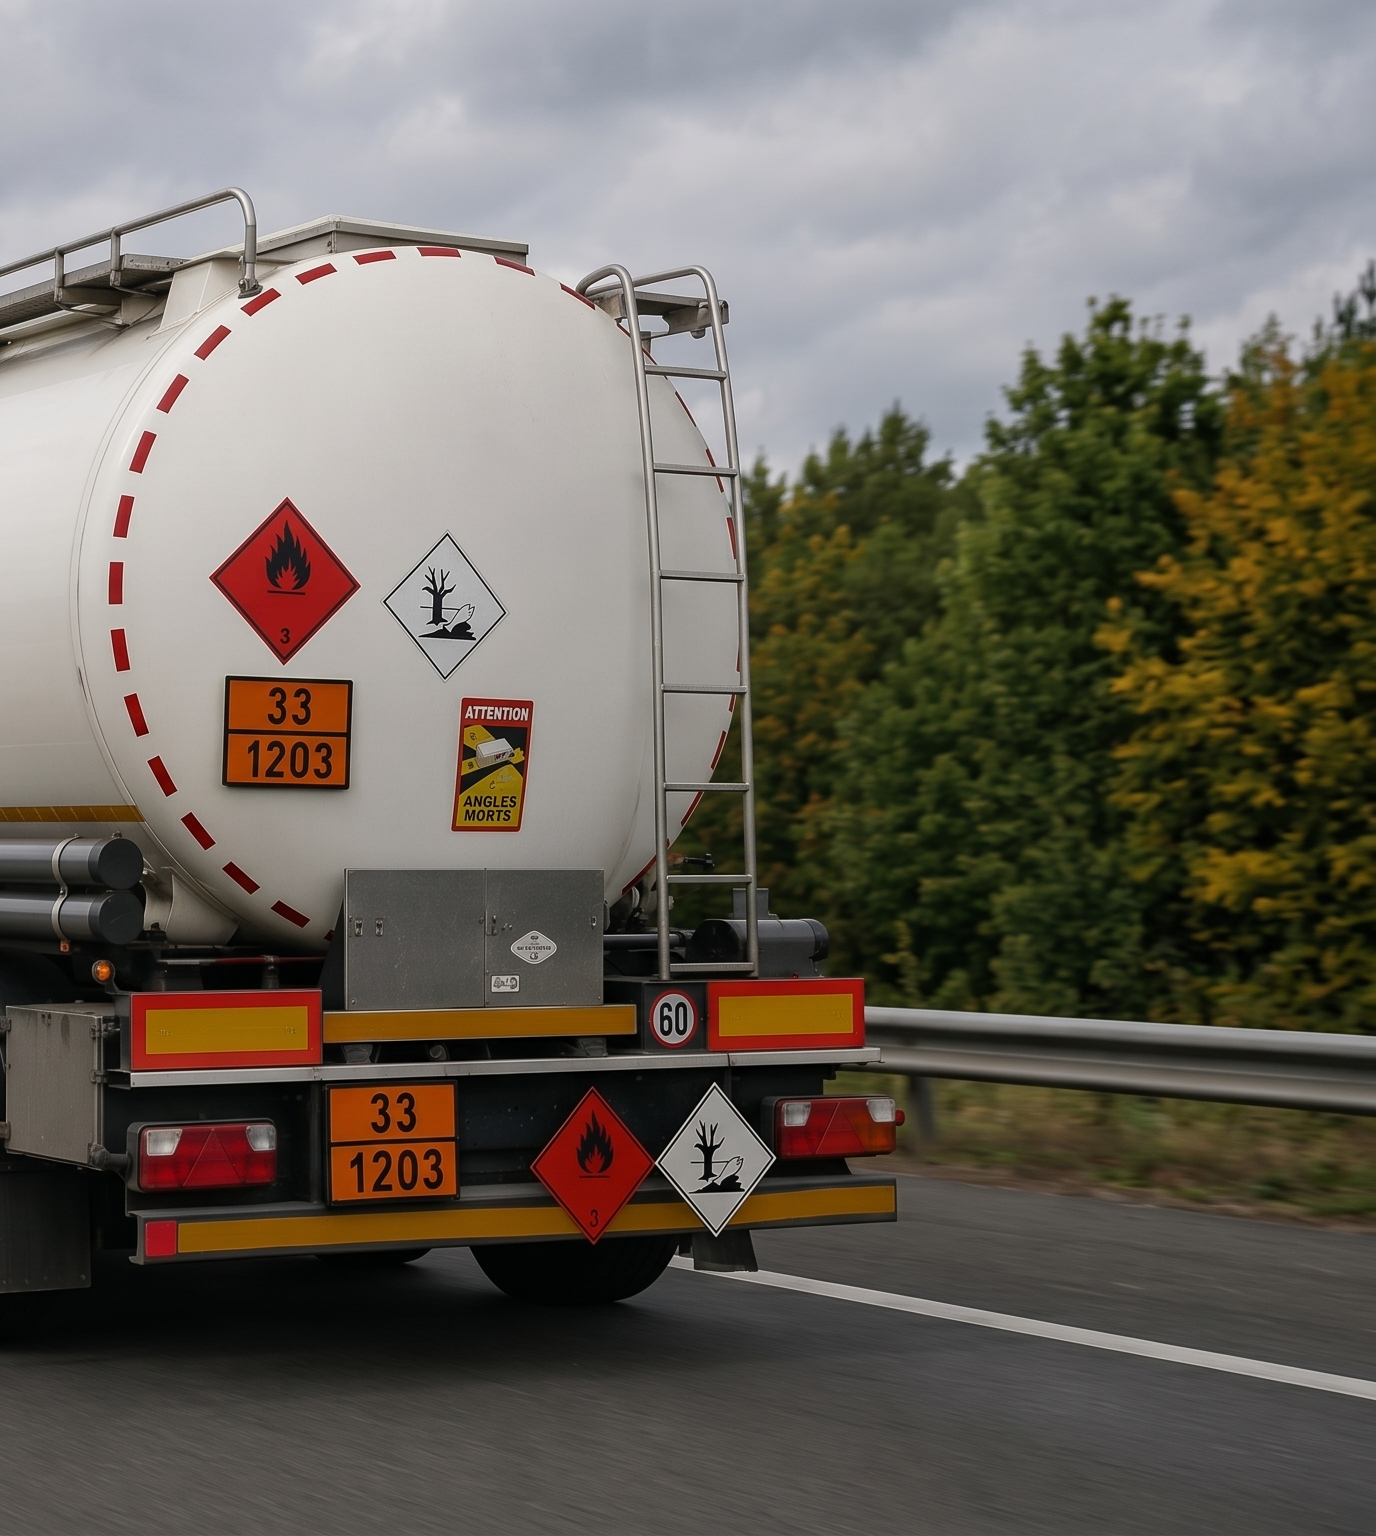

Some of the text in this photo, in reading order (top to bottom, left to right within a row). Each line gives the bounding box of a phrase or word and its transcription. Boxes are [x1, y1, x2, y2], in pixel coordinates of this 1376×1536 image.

[279, 627, 291, 645] 3
[267, 686, 312, 726] 33
[464, 705, 529, 721] ATTENTION
[247, 739, 333, 780] 1203
[463, 795, 517, 808] ANGLES
[464, 808, 512, 822] MORTS
[659, 1001, 688, 1037] 60
[370, 1091, 417, 1134] 33
[349, 1148, 444, 1194] 1203
[589, 1208, 599, 1228] 3
